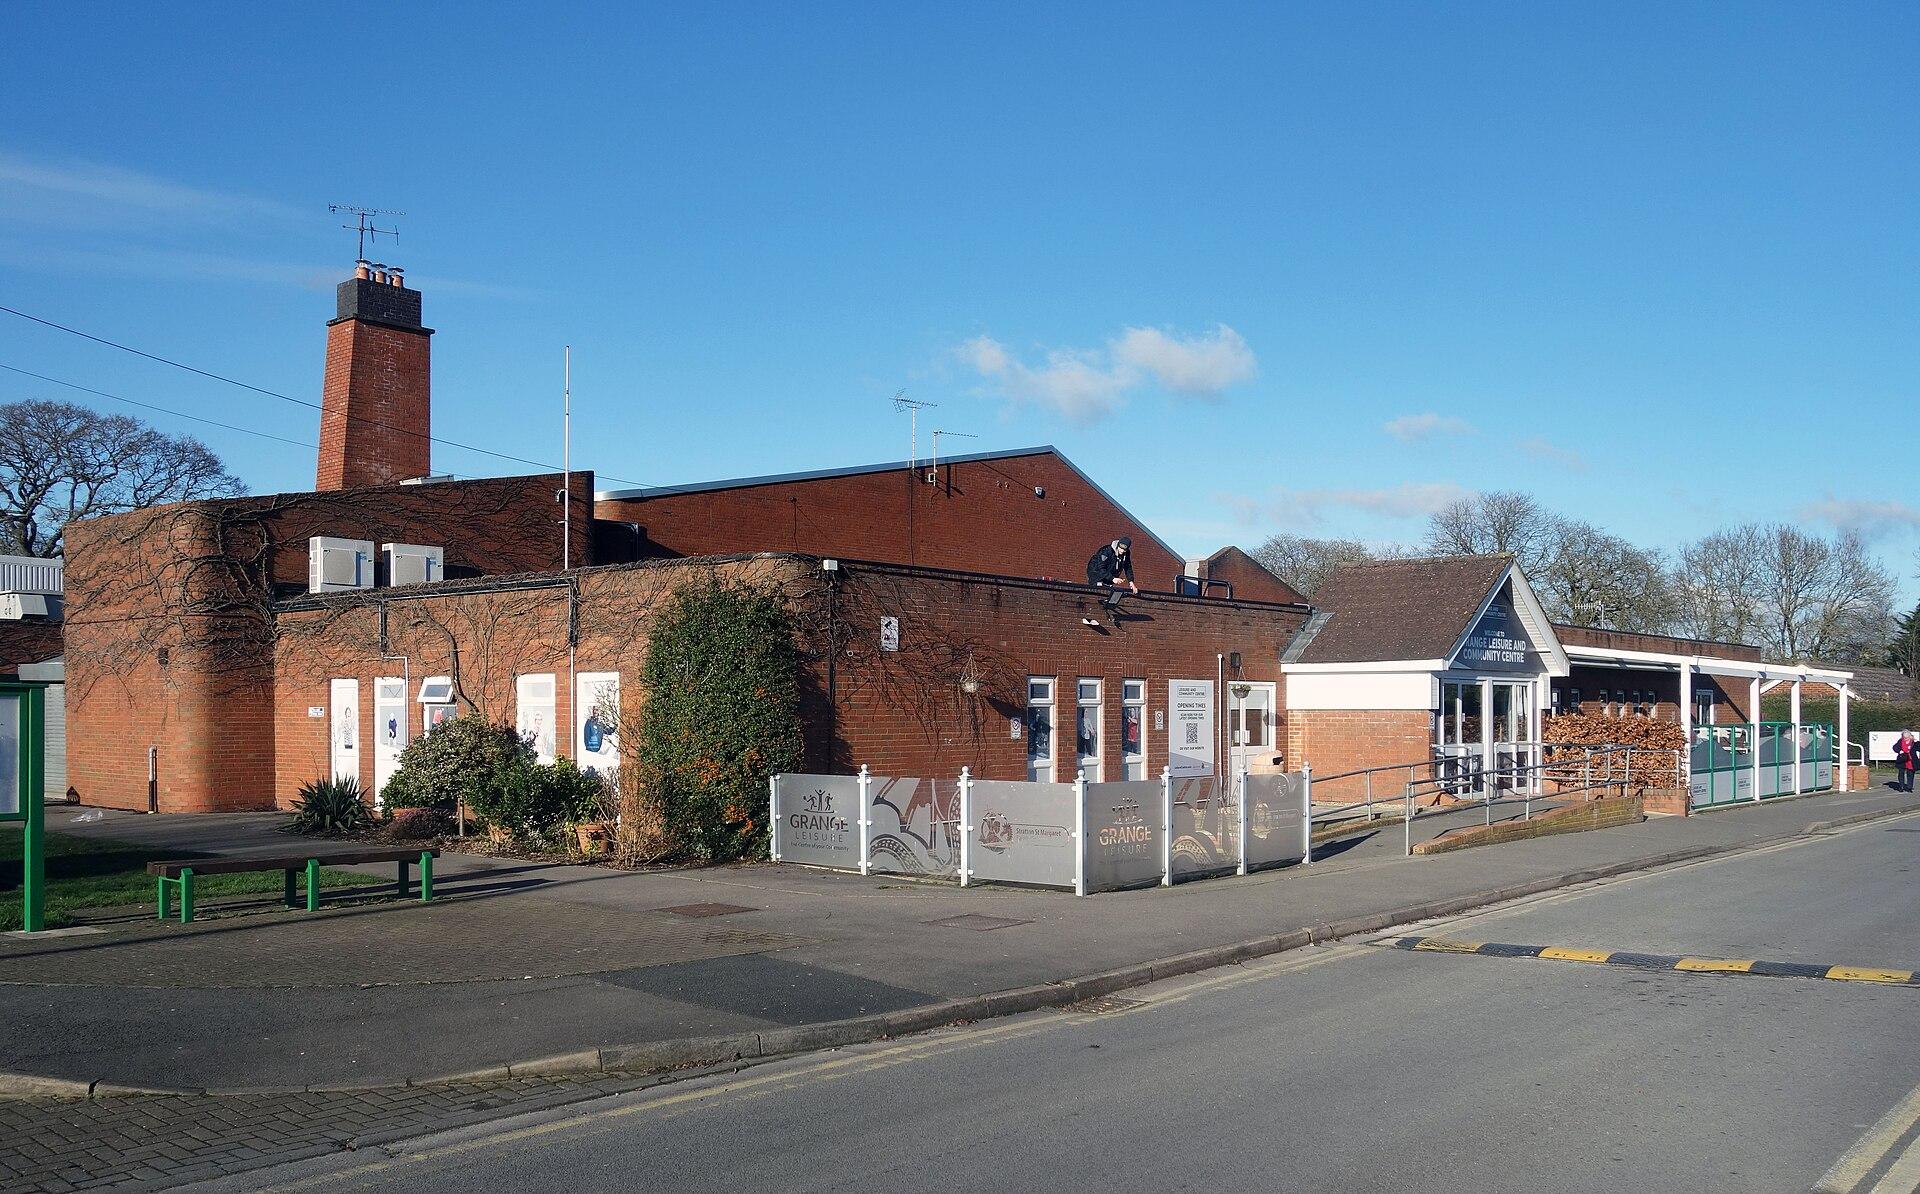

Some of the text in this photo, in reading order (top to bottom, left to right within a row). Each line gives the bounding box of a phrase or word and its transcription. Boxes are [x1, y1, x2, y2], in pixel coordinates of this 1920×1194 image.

[1465, 636, 1526, 651] RANGE LEISURE AND
[1463, 649, 1525, 663] COMMUNITY CENTRE
[790, 814, 849, 832] GRANGE
[795, 831, 844, 843] LEISURE
[1040, 829, 1062, 837] Margaret
[1099, 825, 1152, 846] GRANGE
[1104, 843, 1148, 857] LEISURE
